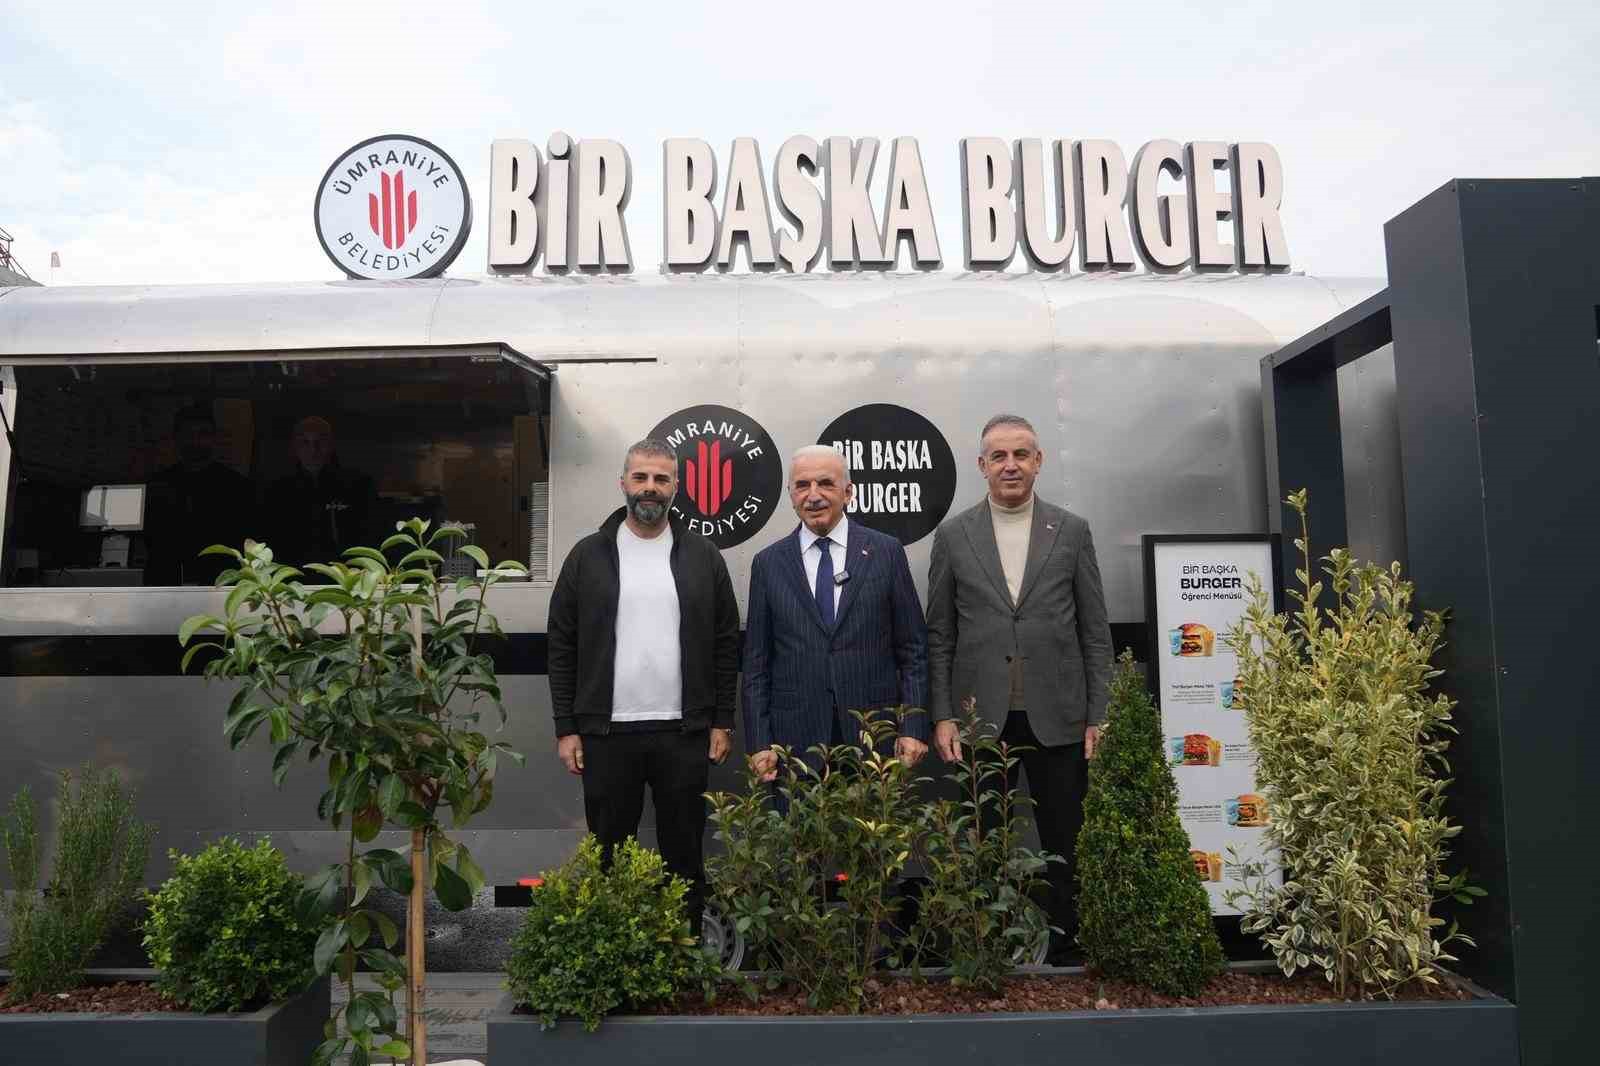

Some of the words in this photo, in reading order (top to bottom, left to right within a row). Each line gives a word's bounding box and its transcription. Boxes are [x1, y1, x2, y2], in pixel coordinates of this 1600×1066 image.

[662, 135, 943, 275] BAŞKA
[960, 137, 1292, 273] BURGER
[871, 440, 933, 472] BAŞKA
[847, 482, 922, 513] BURGER
[1202, 565, 1238, 575] BAŞKA
[1181, 578, 1241, 589] BURGER
[1181, 592, 1212, 602] Öğrenci
